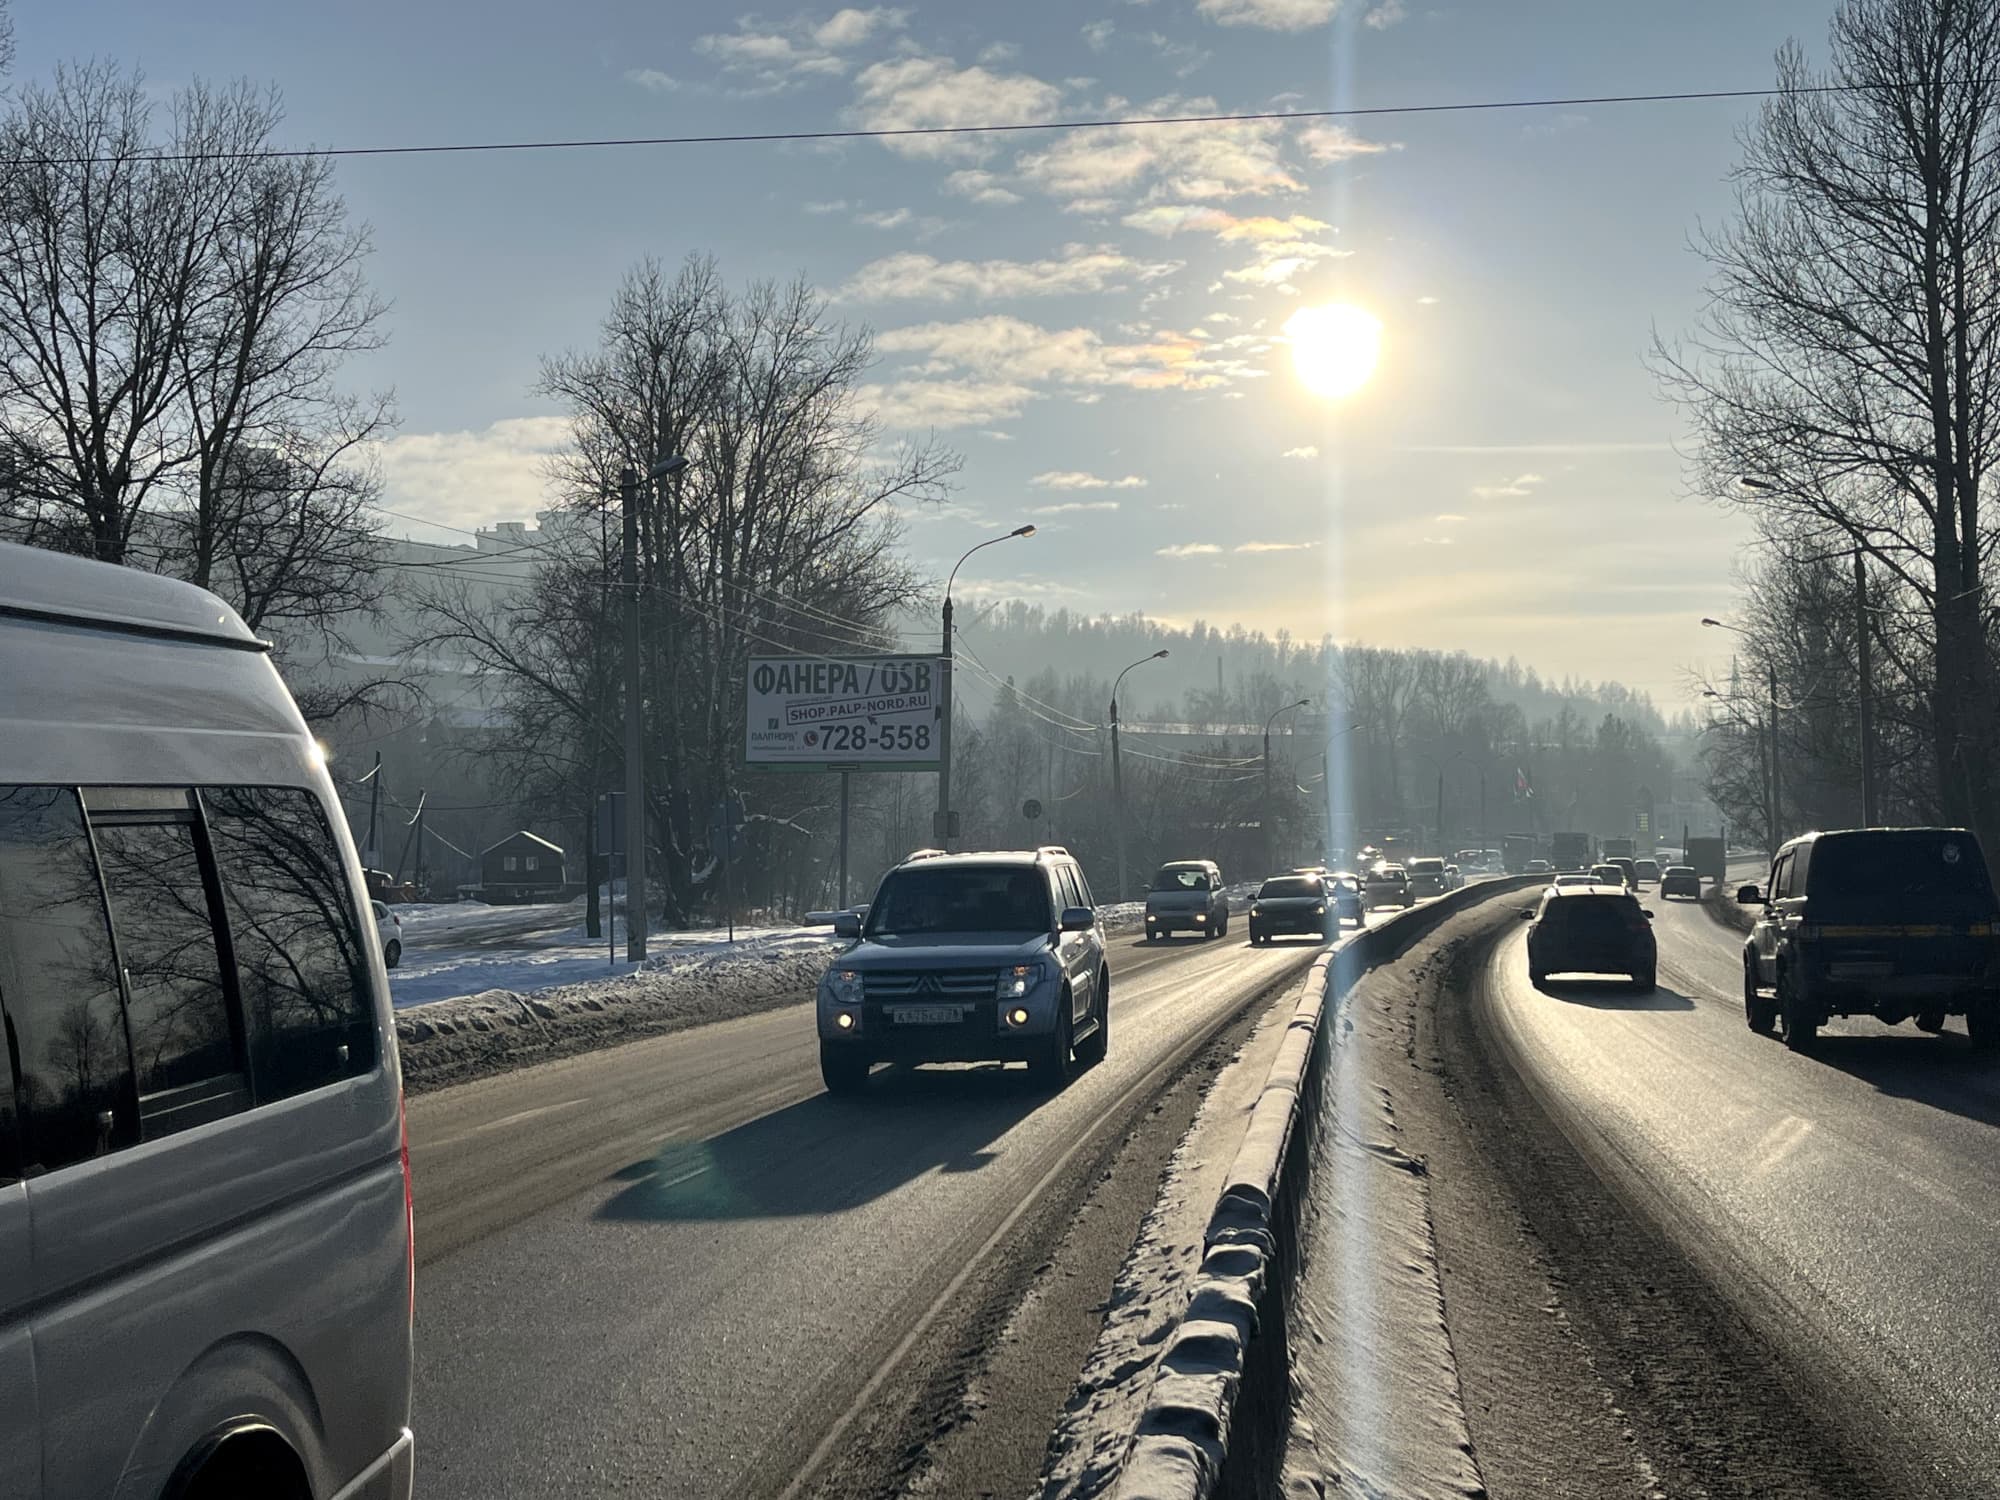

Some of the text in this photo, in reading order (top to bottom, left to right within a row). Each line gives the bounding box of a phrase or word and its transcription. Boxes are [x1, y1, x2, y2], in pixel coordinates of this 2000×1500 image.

[753, 663, 859, 695] ФАНЕРА
[881, 662, 931, 693] OSB
[790, 695, 927, 721] SHOP.PALP-NORD.RU
[820, 725, 930, 751] 728-558
